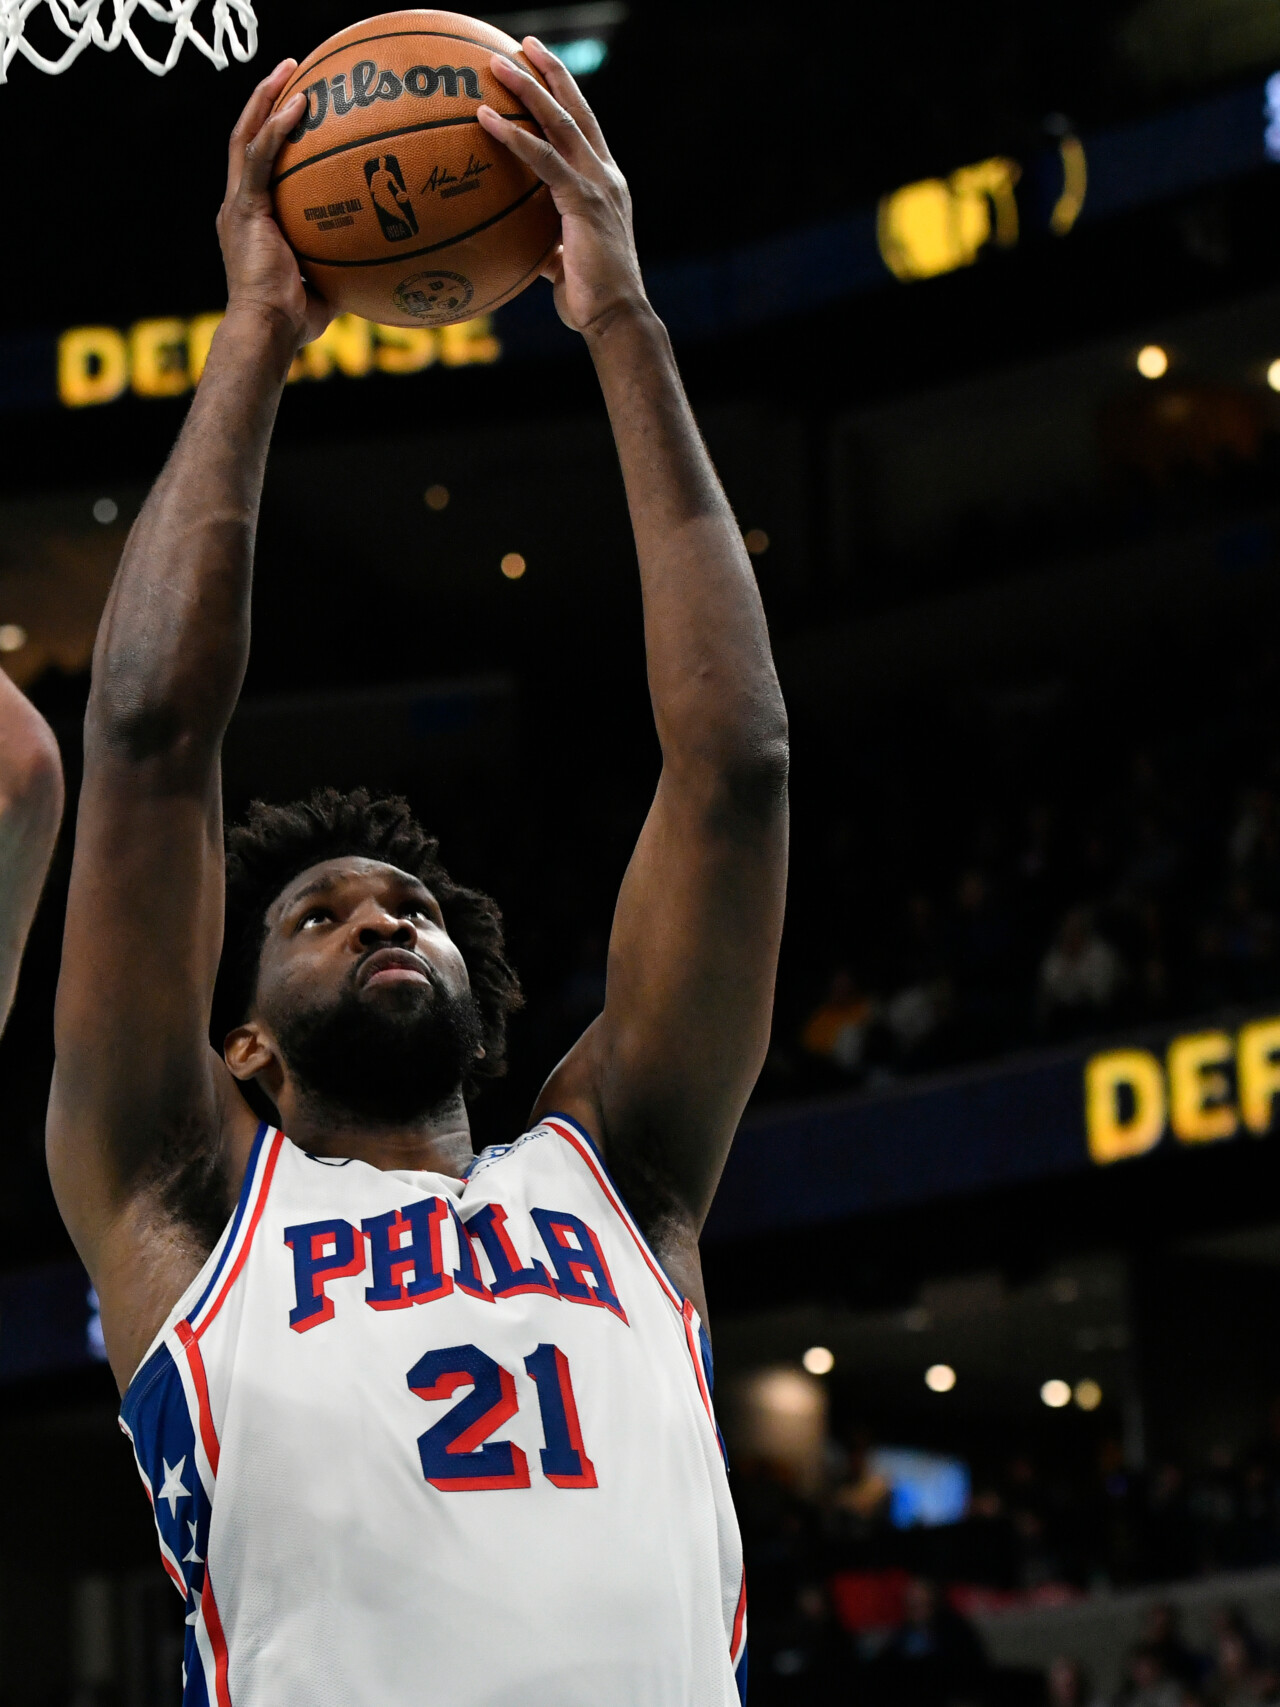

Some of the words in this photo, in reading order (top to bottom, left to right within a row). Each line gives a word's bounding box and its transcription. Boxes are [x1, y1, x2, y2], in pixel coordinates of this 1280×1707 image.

[58, 312, 500, 407] DENSE
[283, 1196, 630, 1334] PHILA
[406, 1343, 599, 1492] 21
